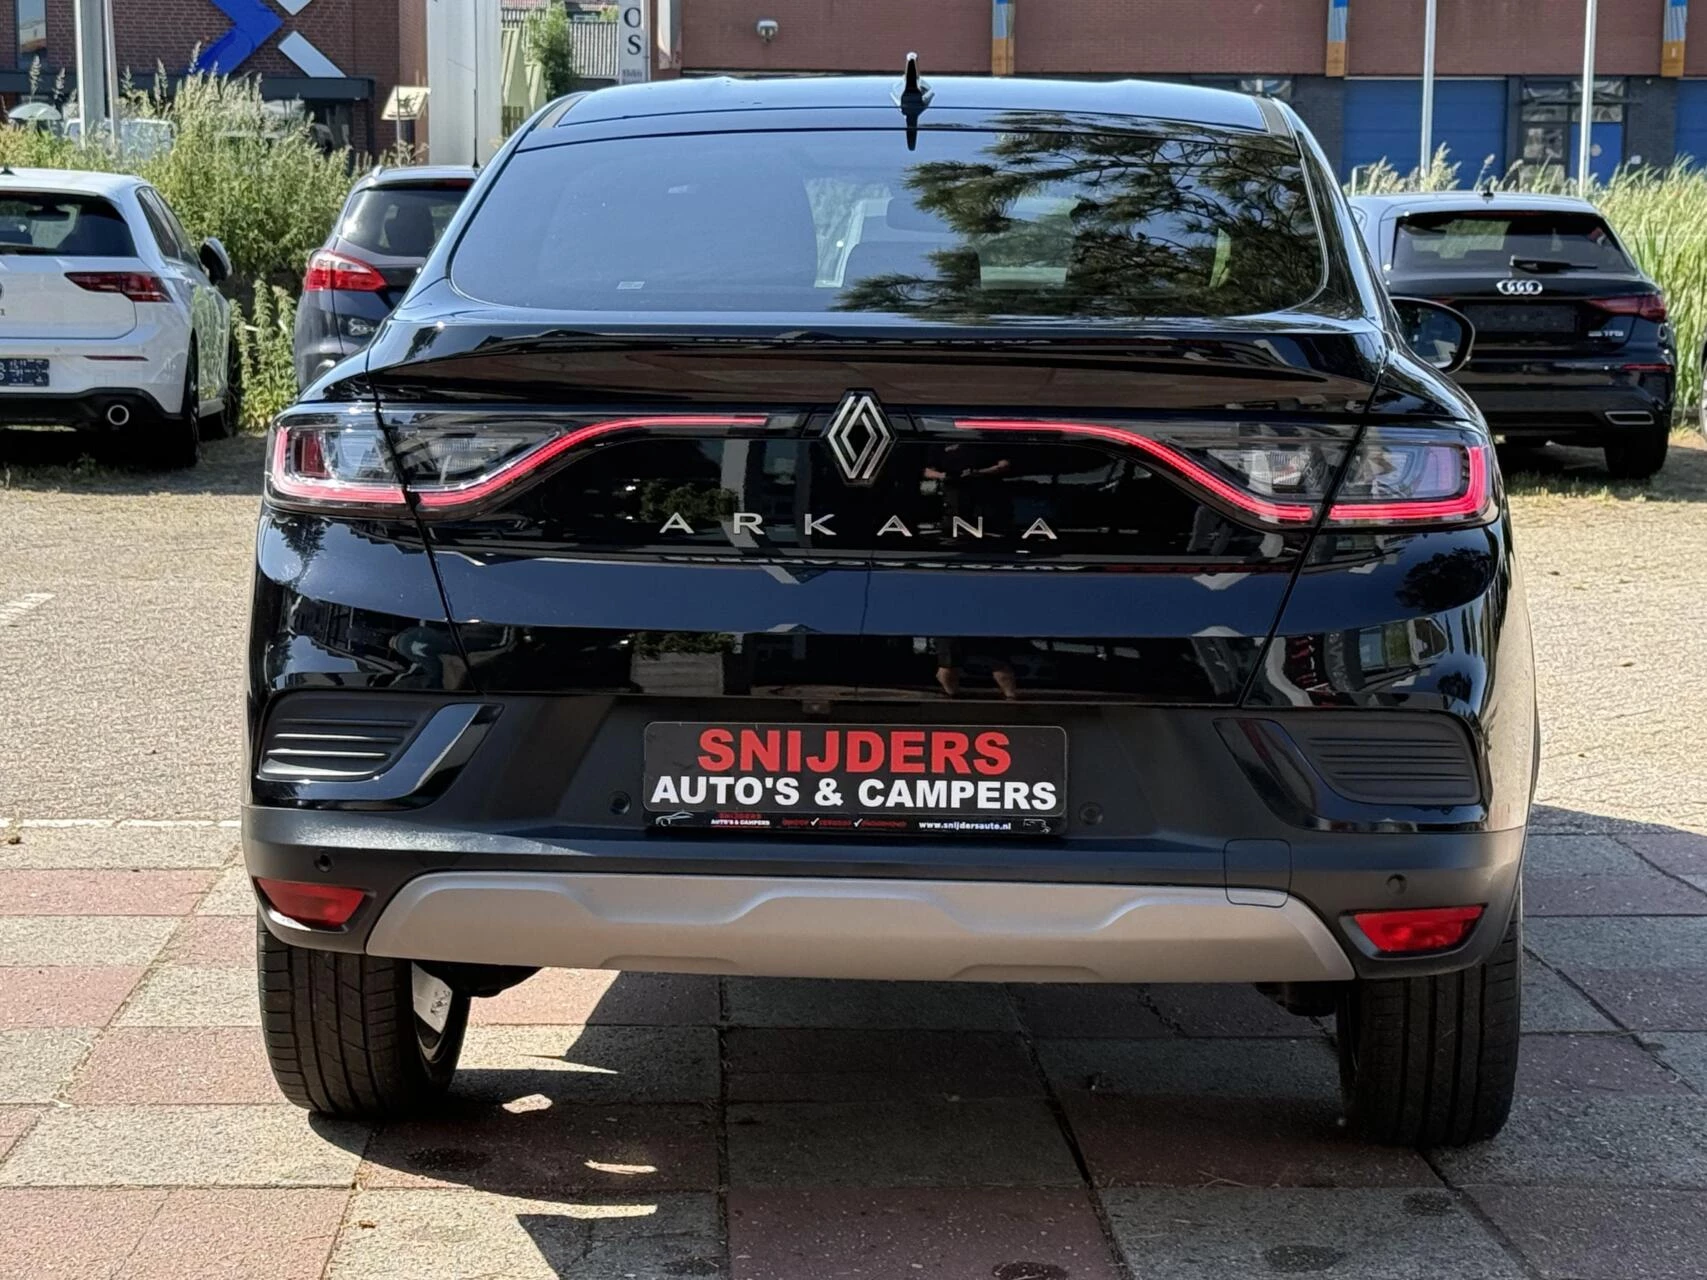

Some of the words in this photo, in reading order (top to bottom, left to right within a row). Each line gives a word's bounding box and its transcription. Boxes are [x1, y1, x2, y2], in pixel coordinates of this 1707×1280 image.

[659, 512, 1058, 540] ARKANA
[697, 728, 1012, 776] SNIJDERS
[651, 776, 800, 806] AUTO'S
[814, 779, 844, 807] &
[858, 779, 1057, 811] CAMPERS
[918, 821, 1012, 831] www.snijdersauto.nl
